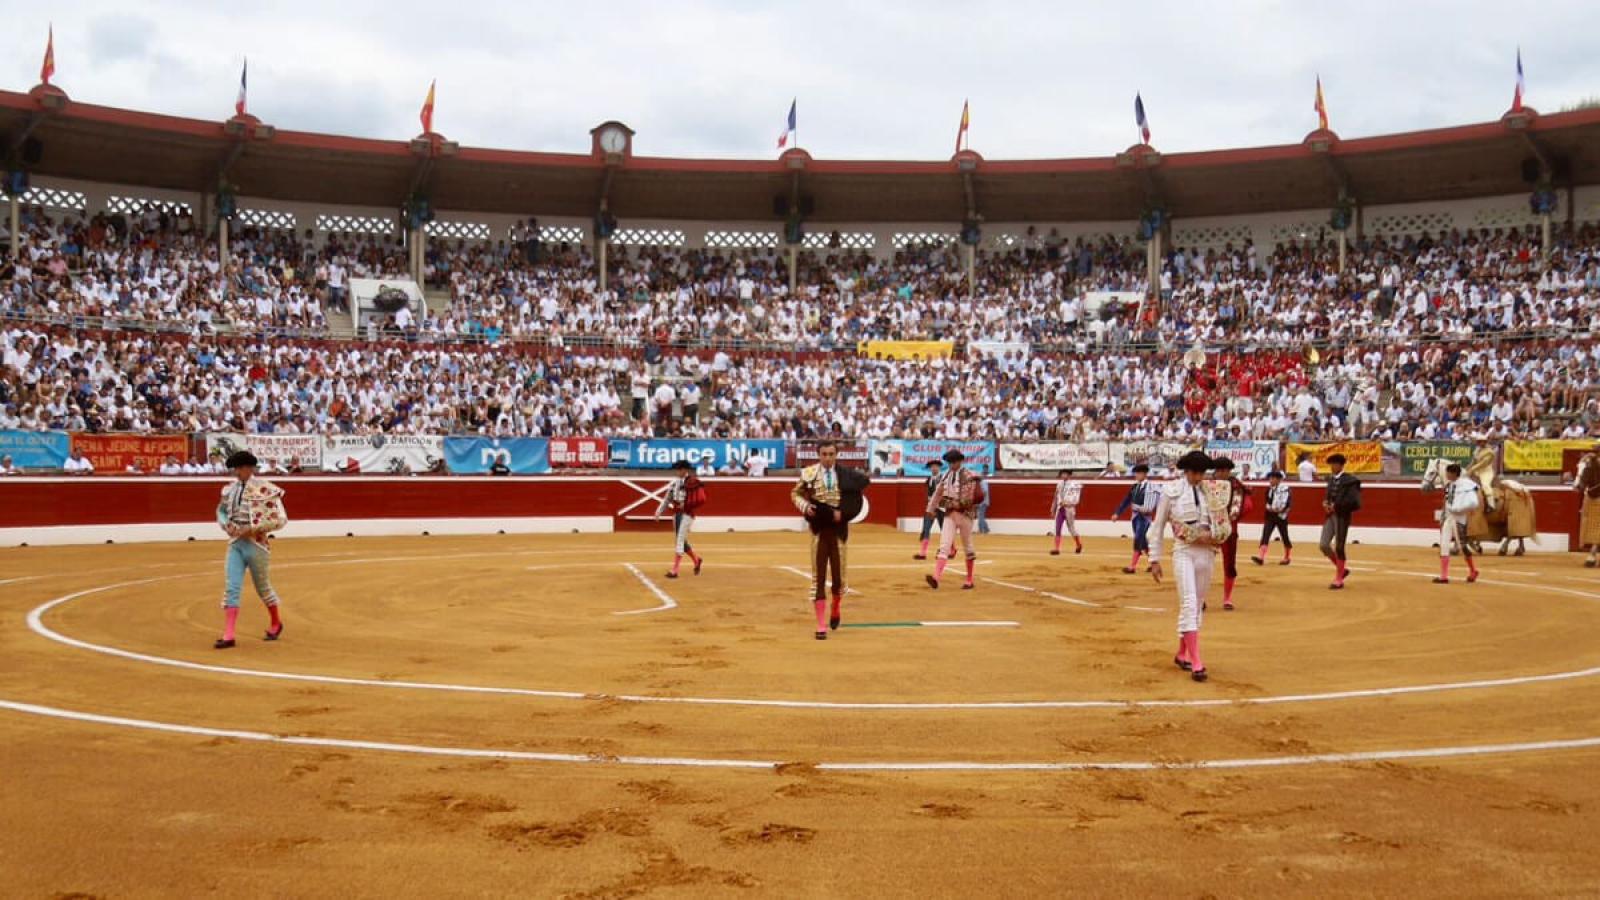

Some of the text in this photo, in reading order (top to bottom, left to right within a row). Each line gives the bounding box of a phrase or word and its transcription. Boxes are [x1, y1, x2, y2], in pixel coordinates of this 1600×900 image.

[107, 440, 141, 453] JEUNE
[912, 444, 942, 453] CLUB
[1406, 446, 1471, 457] CERCLE TAURIN
[579, 451, 604, 462] OUEST
[638, 443, 717, 463] france
[726, 443, 777, 464] blu
[92, 455, 124, 468] SAINT
